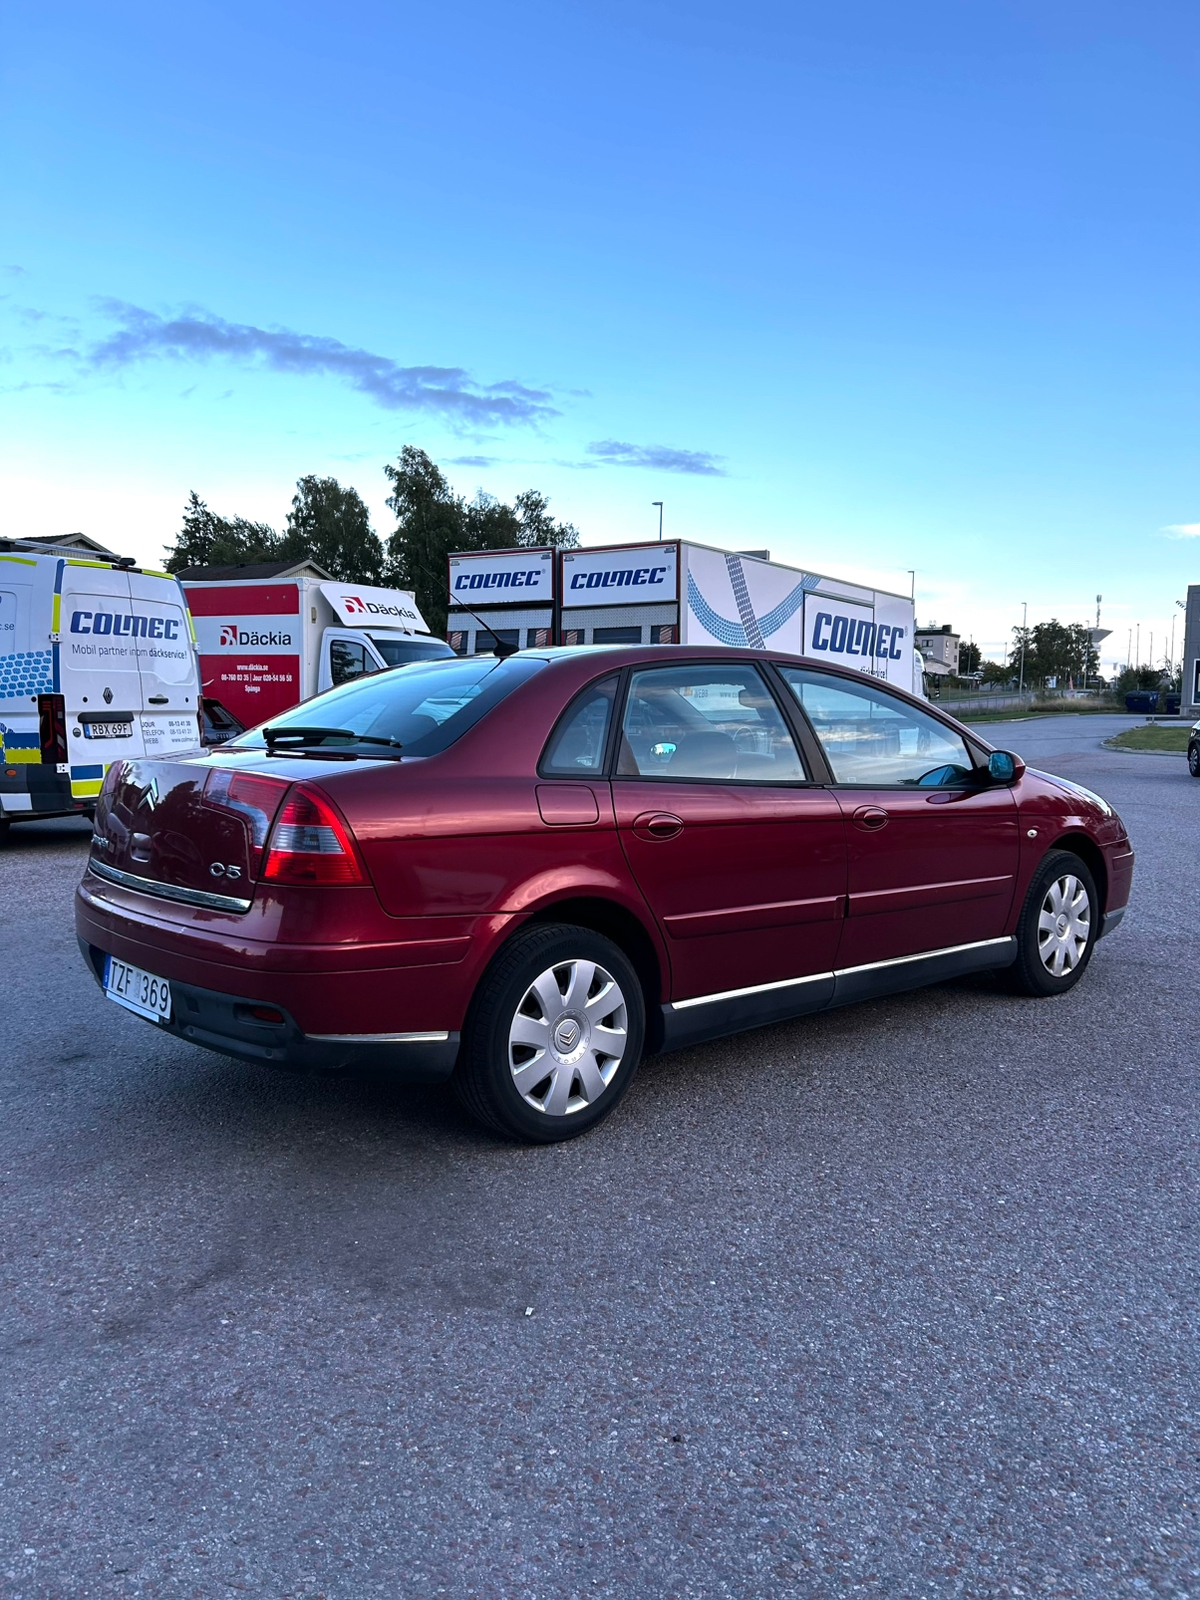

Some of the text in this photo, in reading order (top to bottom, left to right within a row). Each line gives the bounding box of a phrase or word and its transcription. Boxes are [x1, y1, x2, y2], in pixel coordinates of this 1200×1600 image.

[454, 570, 541, 590] COLMEC
[570, 567, 666, 590] COLMEC
[367, 603, 417, 620] Däckia
[70, 611, 179, 640] COLMEC
[239, 632, 292, 646] Däckia
[812, 612, 904, 660] COLMEC
[72, 644, 188, 660] Mobil partner inom däckservice!
[92, 723, 128, 735] RBX 69F
[210, 862, 241, 879] C5
[112, 960, 169, 1012] TZF 369
